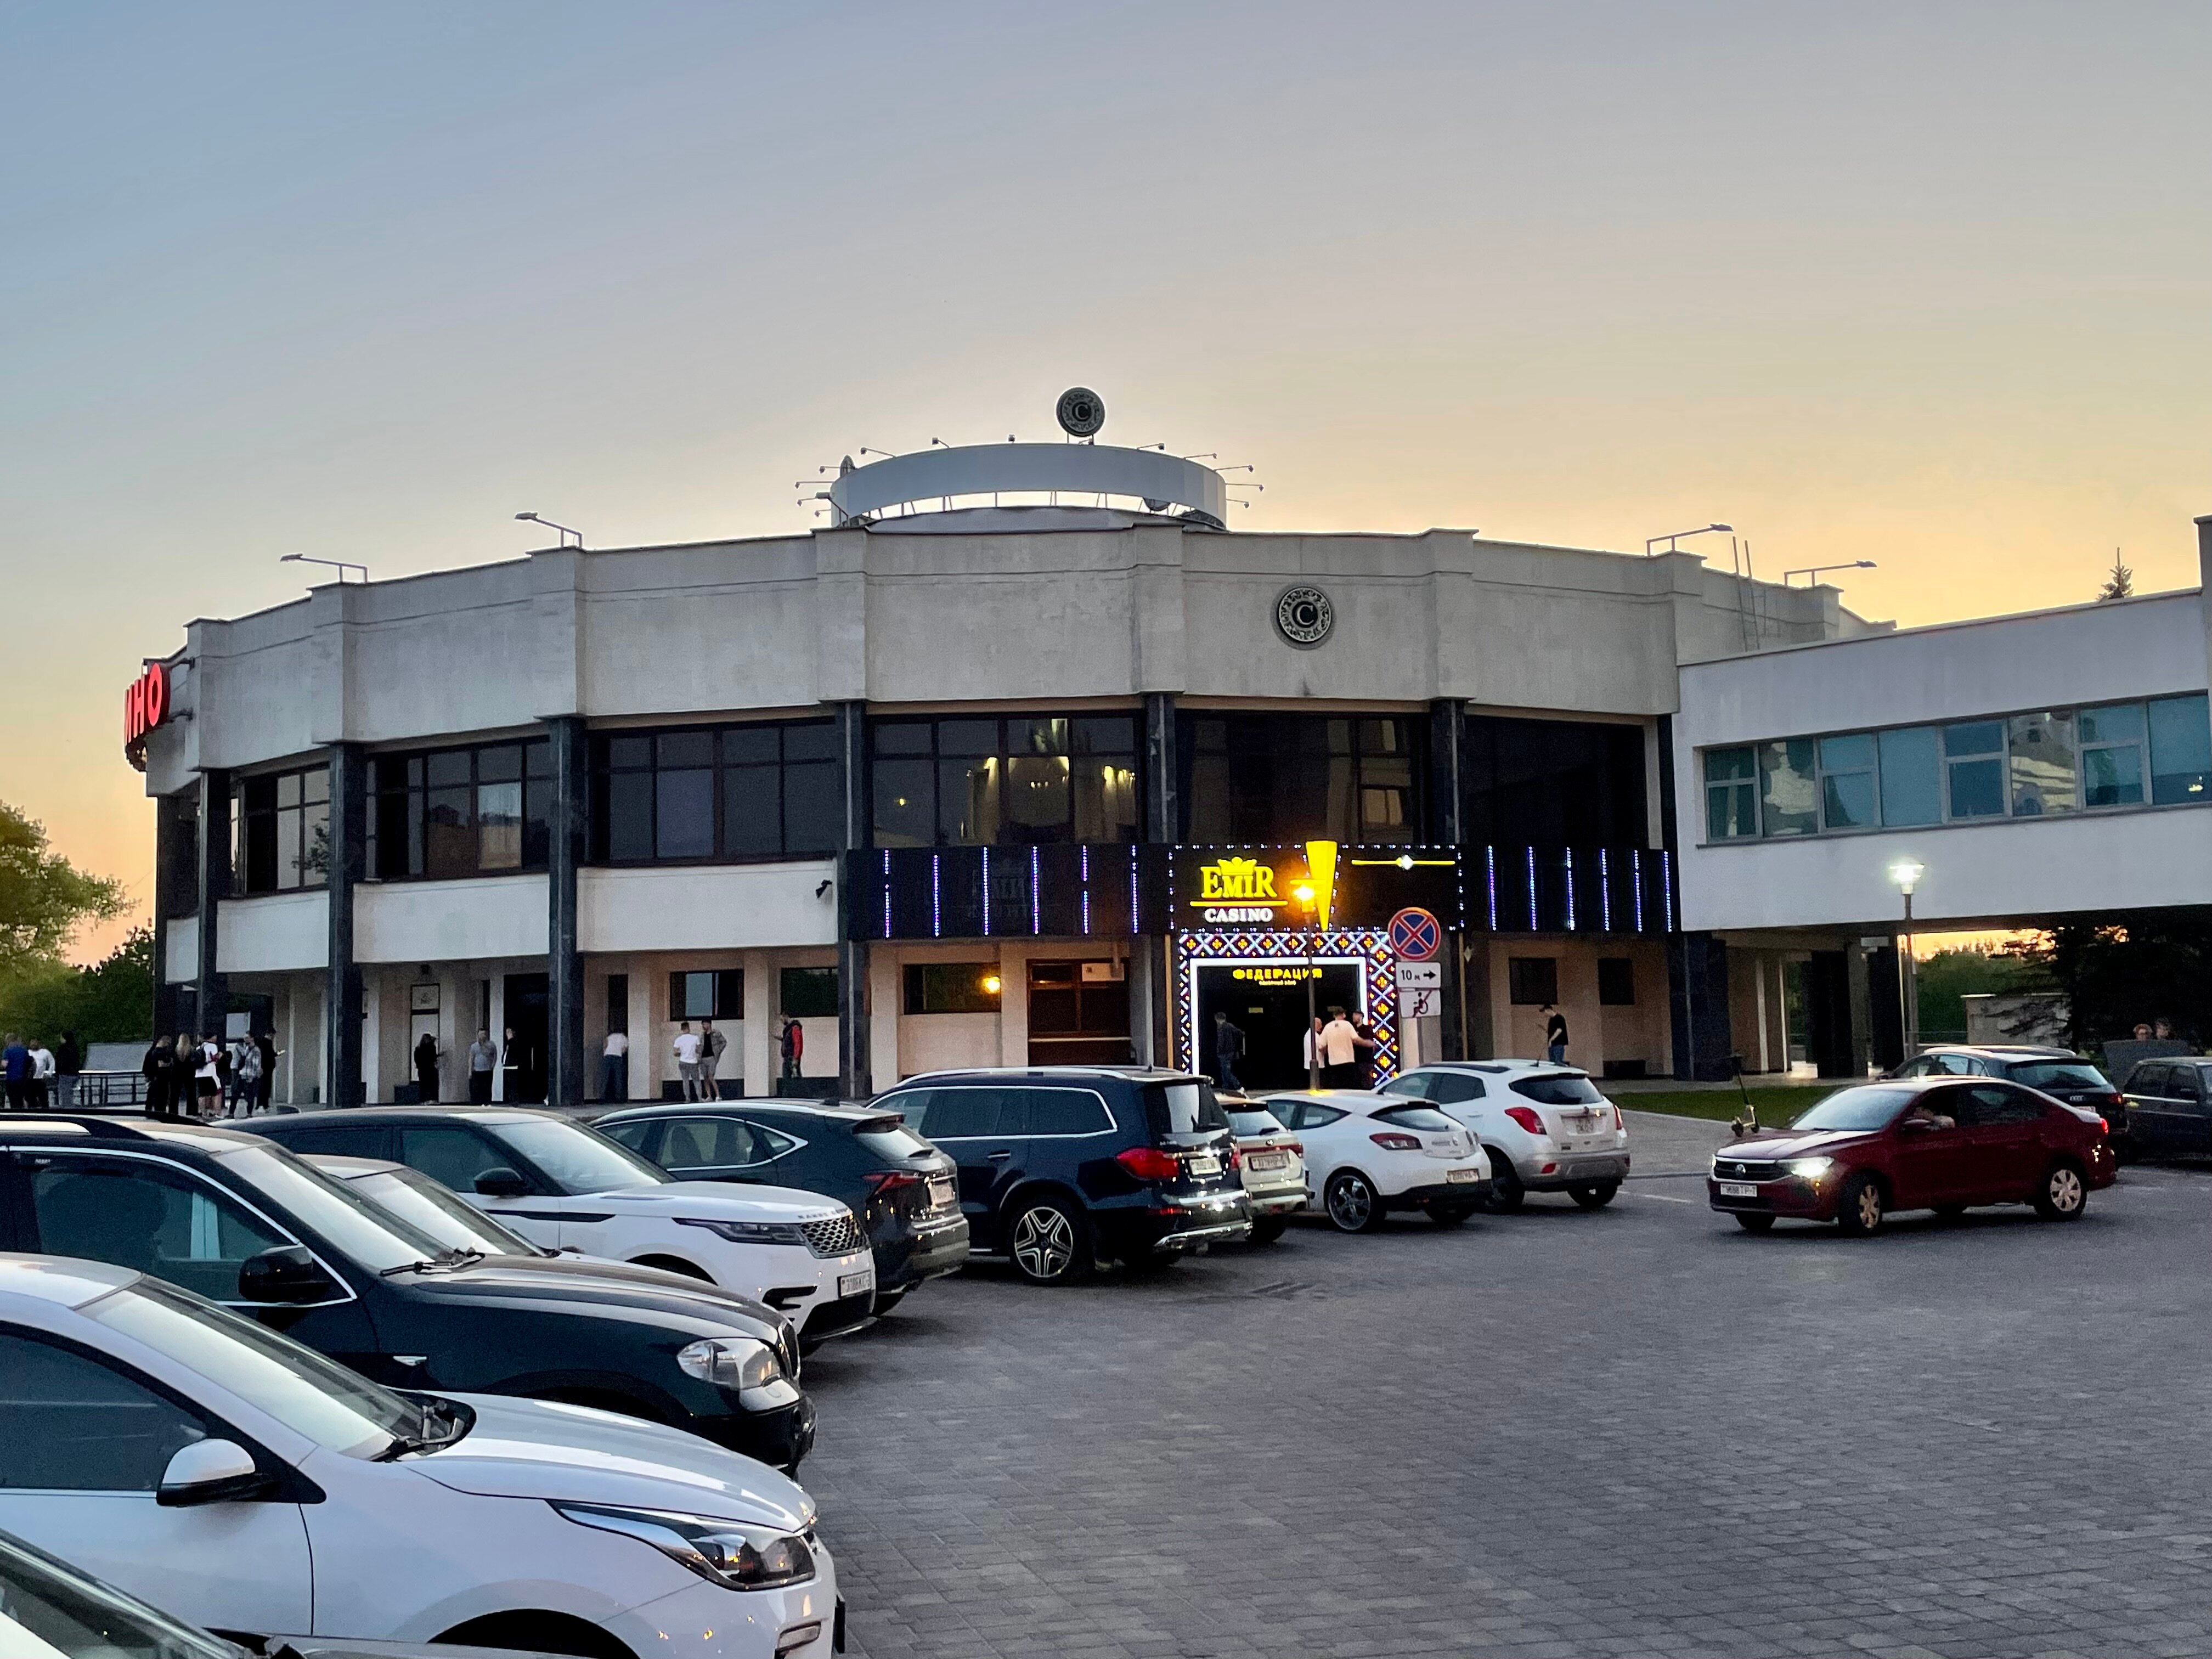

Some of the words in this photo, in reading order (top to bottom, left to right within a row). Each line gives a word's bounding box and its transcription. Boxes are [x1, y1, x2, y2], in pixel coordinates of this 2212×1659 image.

[1200, 866, 1278, 898] EMIR
[1204, 907, 1273, 923] CASINO
[1401, 969, 1412, 981] 10
